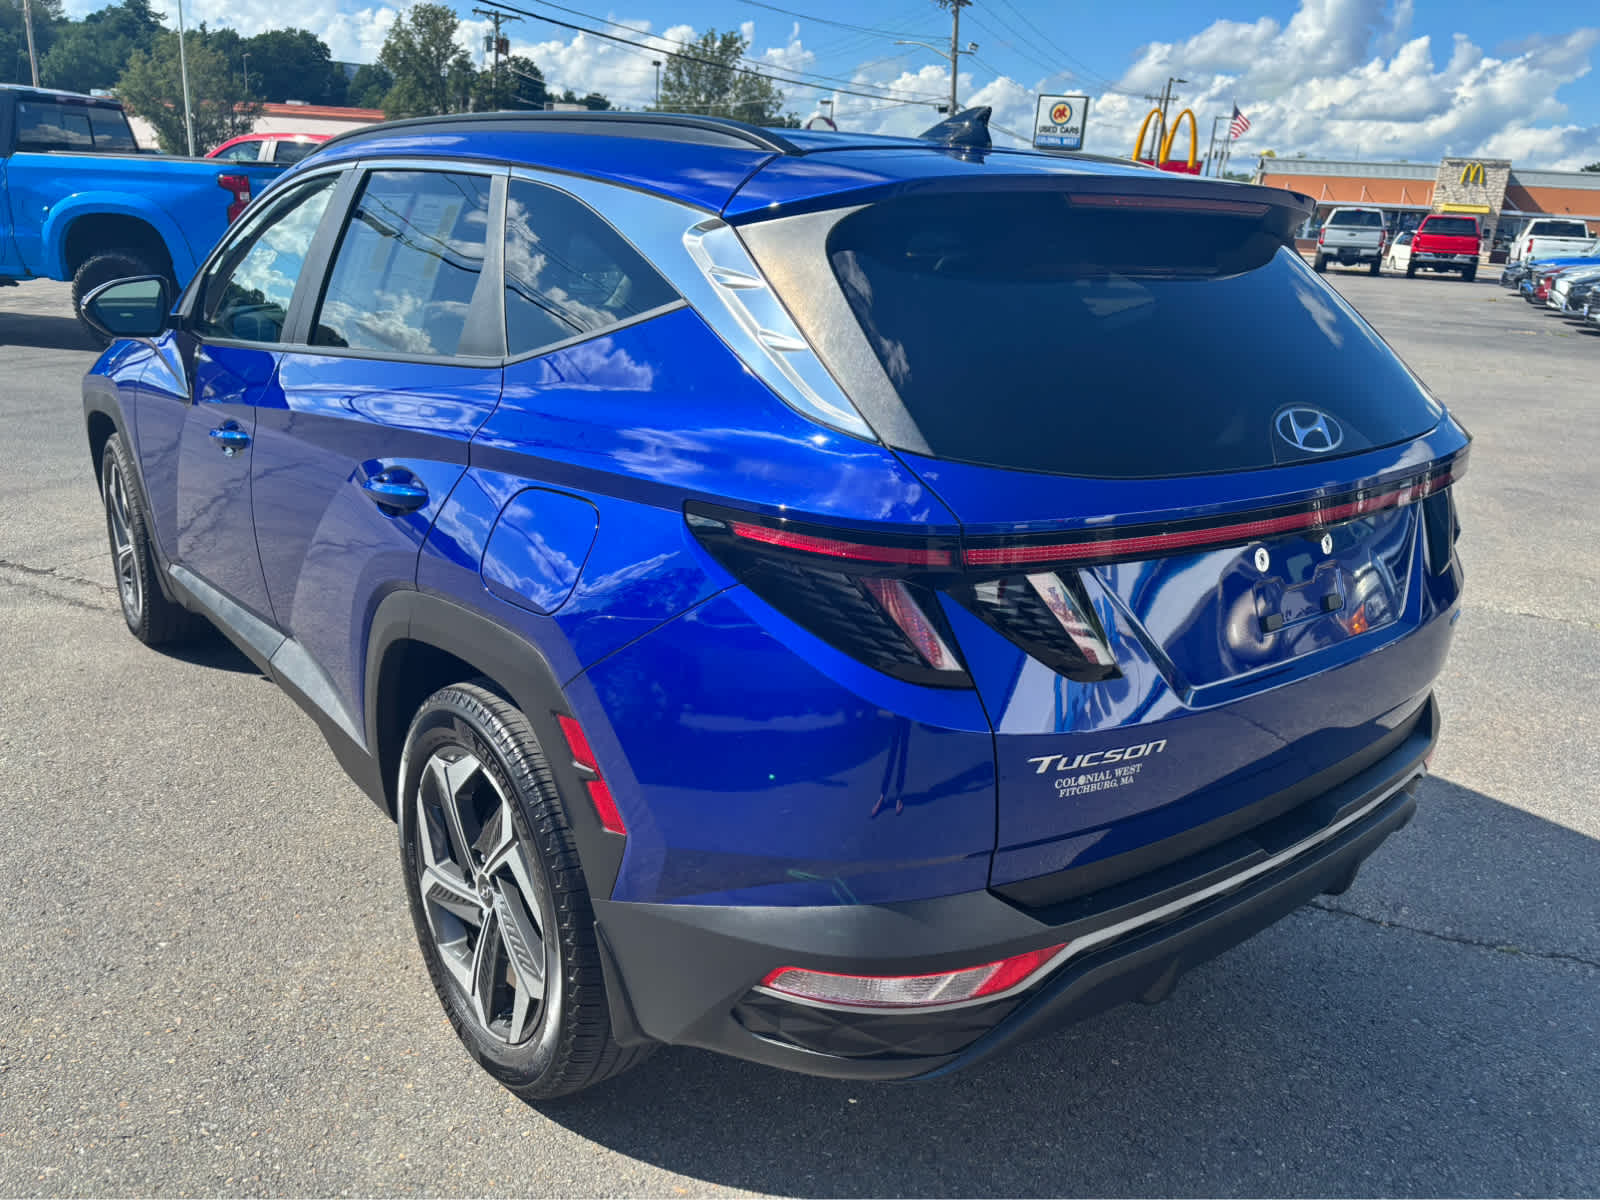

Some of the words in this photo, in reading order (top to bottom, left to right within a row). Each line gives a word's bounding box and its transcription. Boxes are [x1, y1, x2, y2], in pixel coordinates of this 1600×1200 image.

[1038, 125, 1058, 134] USED
[1059, 126, 1080, 135] CARS
[1054, 770, 1112, 789] COLONIAL
[1114, 763, 1143, 778] WEST
[1120, 776, 1134, 787] MA
